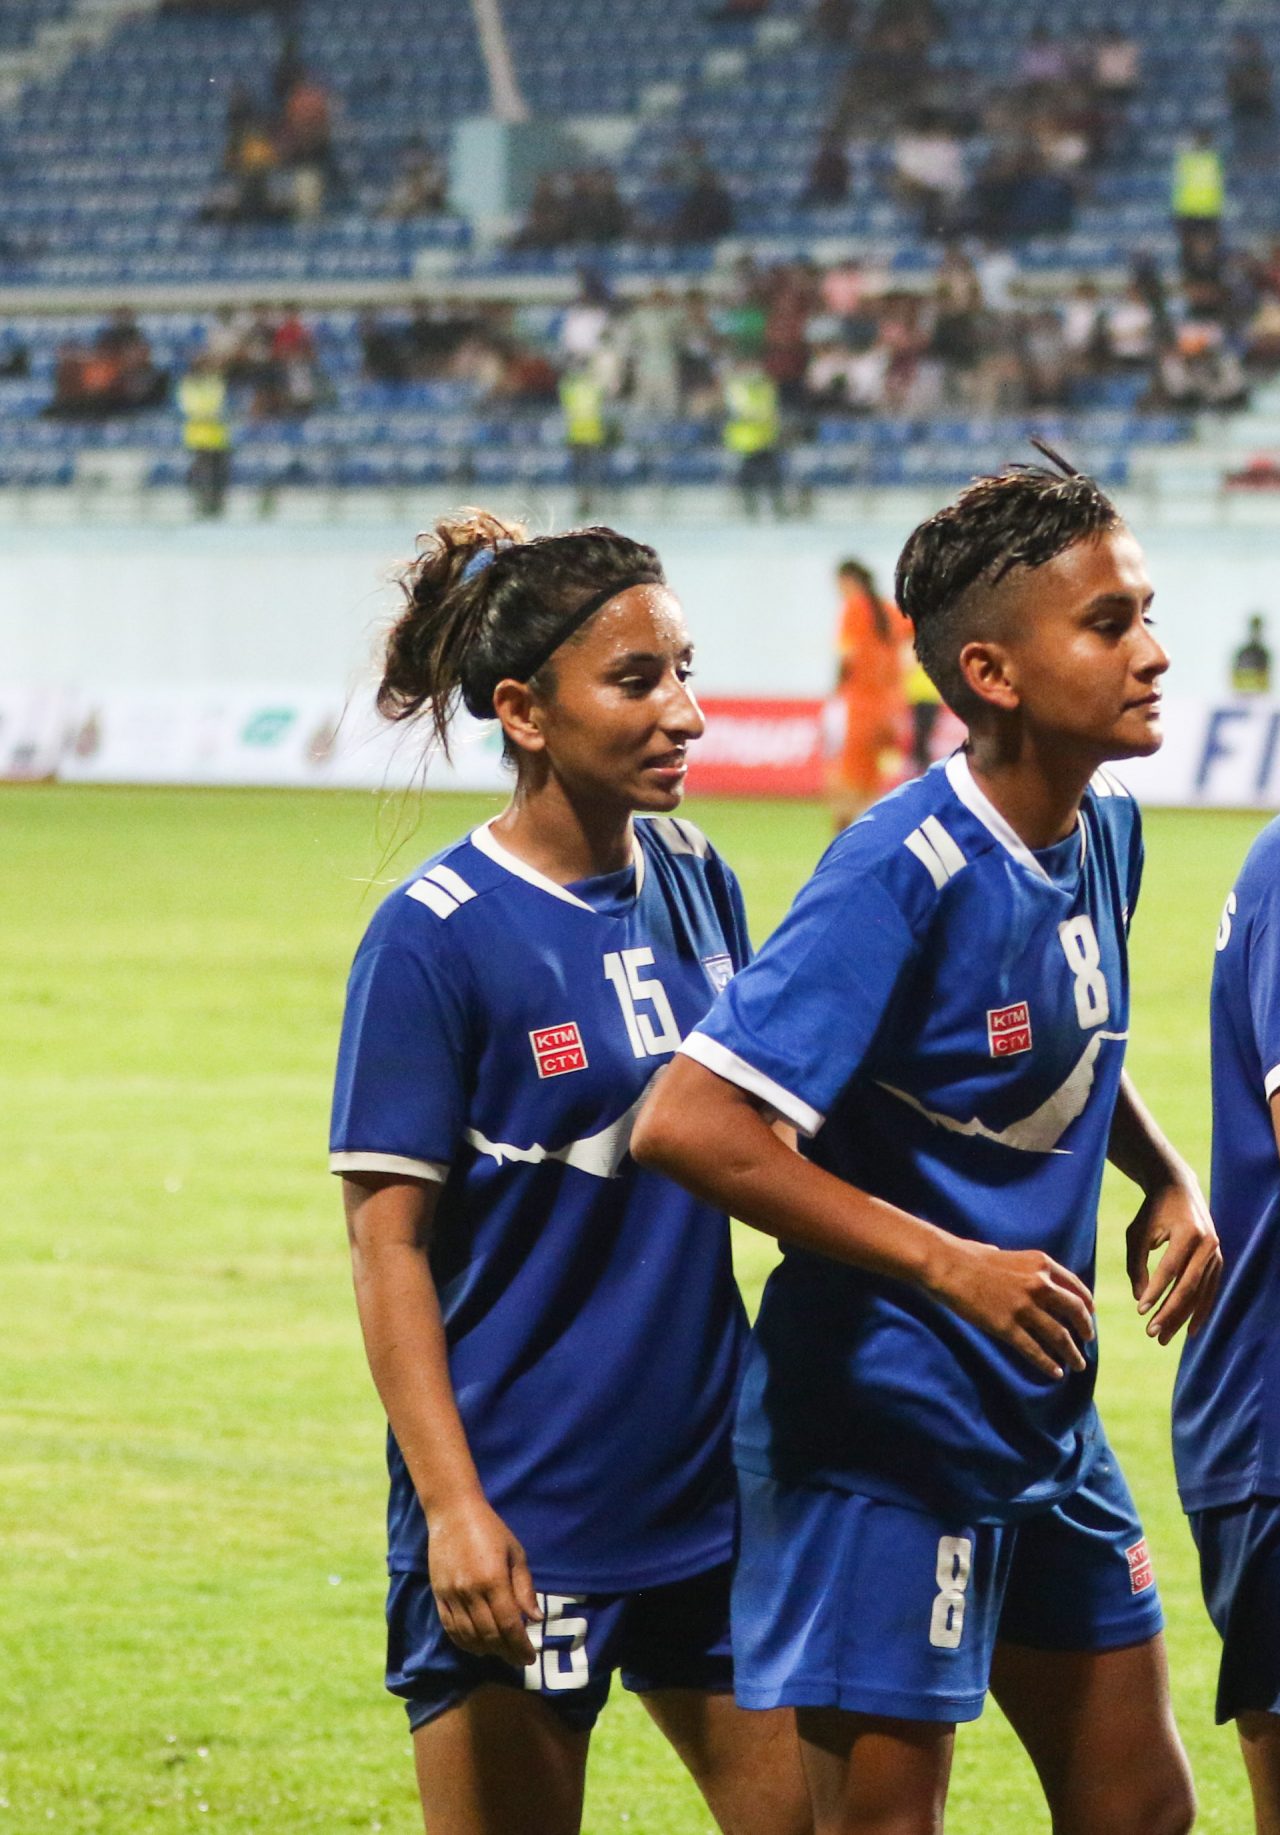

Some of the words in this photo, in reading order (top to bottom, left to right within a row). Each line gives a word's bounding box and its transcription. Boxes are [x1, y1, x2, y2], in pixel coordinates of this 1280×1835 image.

[1058, 914, 1110, 1030] 8
[603, 946, 683, 1059] 15
[994, 1009, 1025, 1028] KTM
[536, 1029, 576, 1049] KTM
[996, 1033, 1026, 1051] CTY
[543, 1052, 580, 1072] CTY
[929, 1535, 972, 1649] 8
